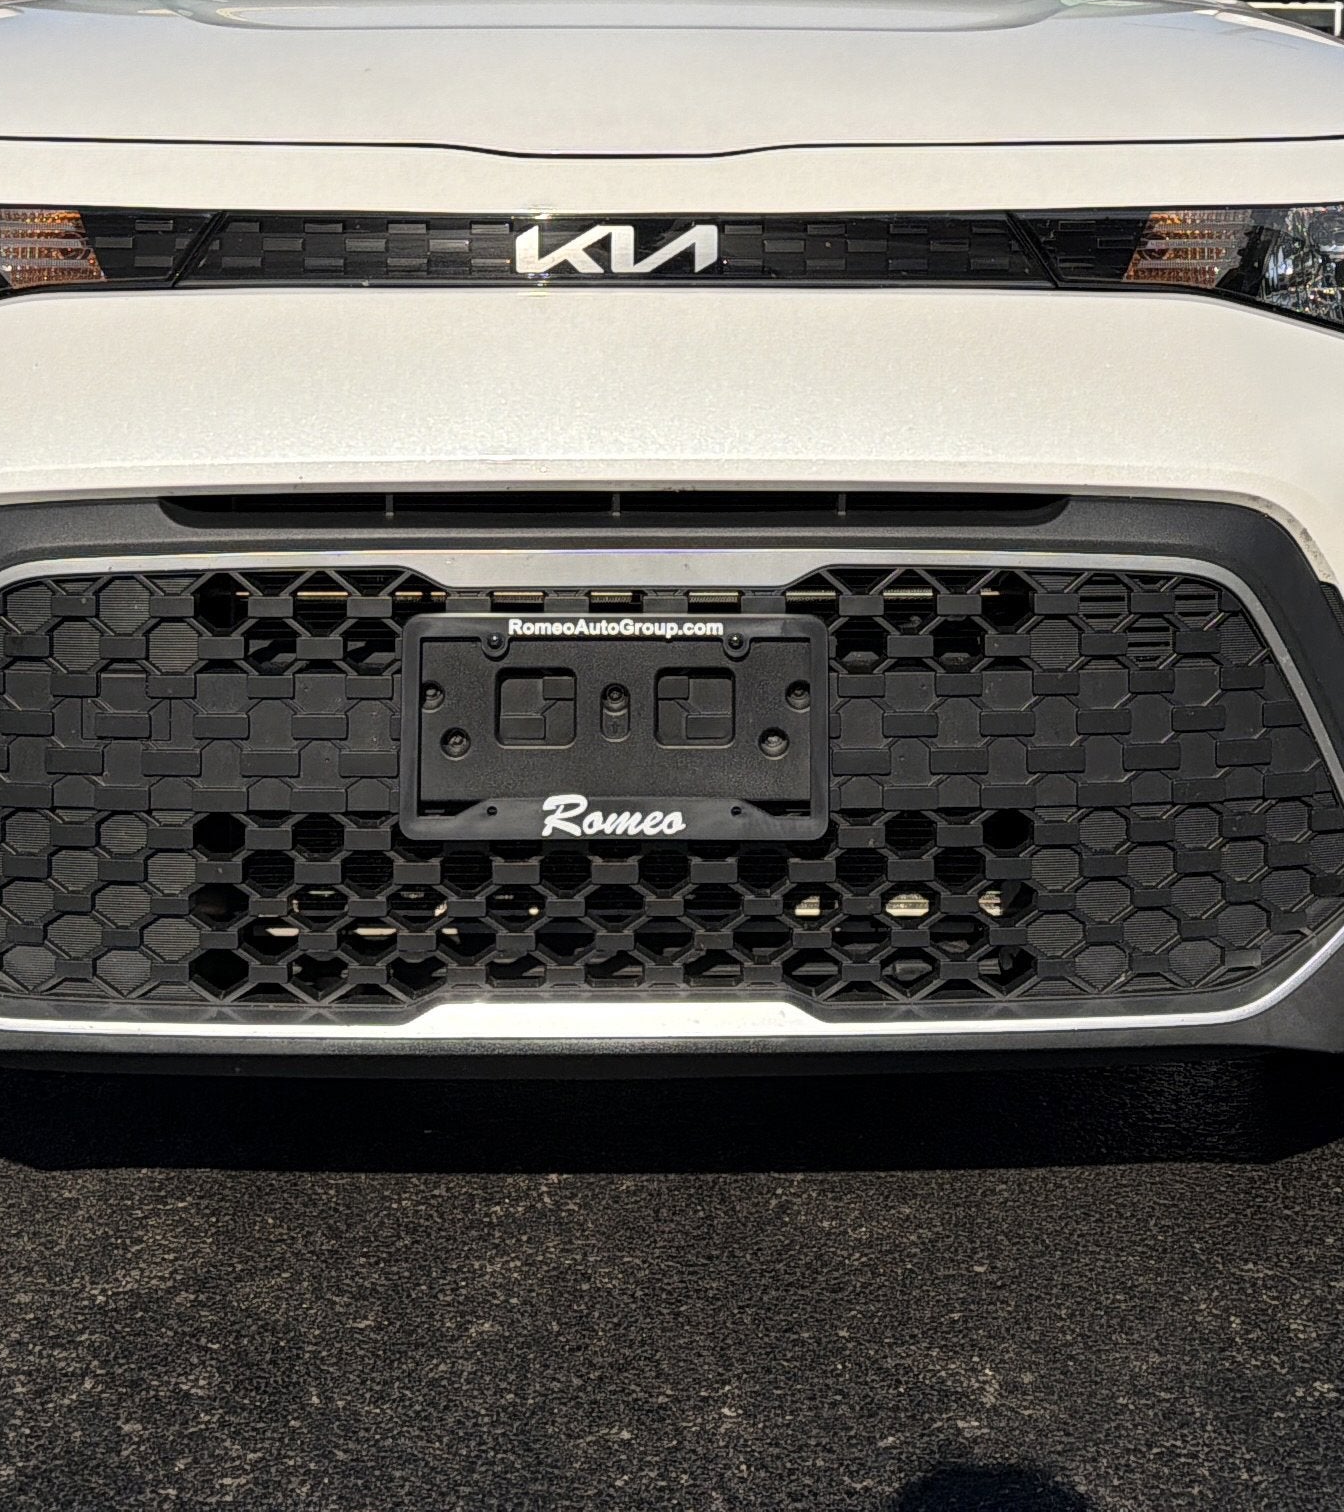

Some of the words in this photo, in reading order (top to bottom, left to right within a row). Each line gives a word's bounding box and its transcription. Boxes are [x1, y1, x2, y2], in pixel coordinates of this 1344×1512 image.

[515, 224, 718, 273] KIA
[508, 618, 724, 639] RomeoAutoGroup.com
[541, 794, 687, 836] Romeo
